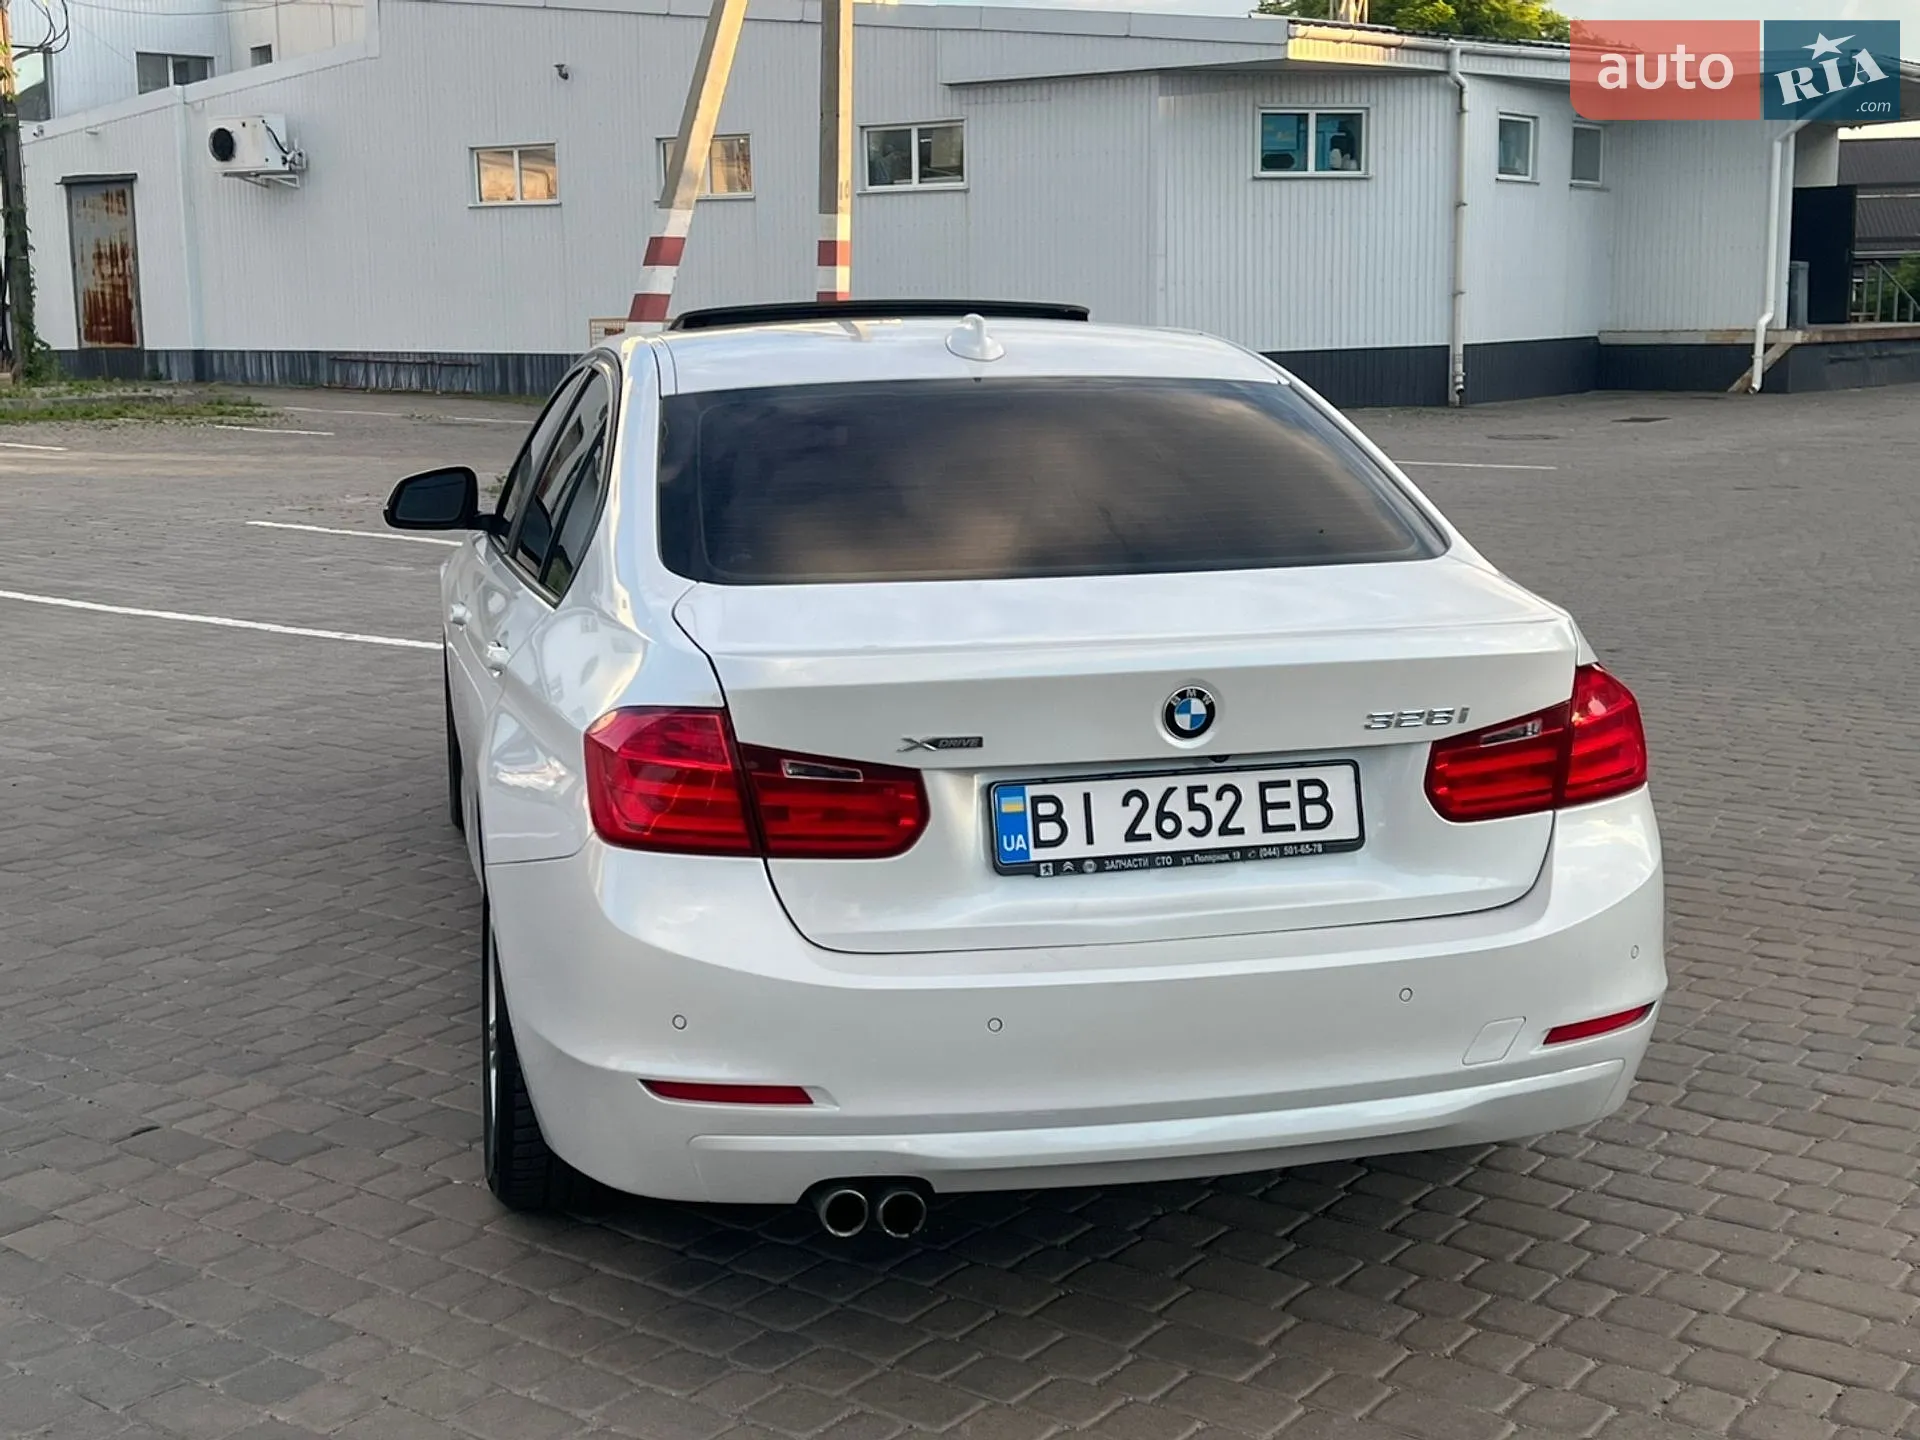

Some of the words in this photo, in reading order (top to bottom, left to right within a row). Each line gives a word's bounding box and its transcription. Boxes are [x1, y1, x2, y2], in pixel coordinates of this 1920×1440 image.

[1364, 706, 1470, 730] 328i
[1030, 791, 1095, 849] BI
[1121, 783, 1245, 843] 2652
[1258, 778, 1334, 834] EB
[1003, 833, 1027, 851] UA
[1155, 855, 1173, 866] СТО
